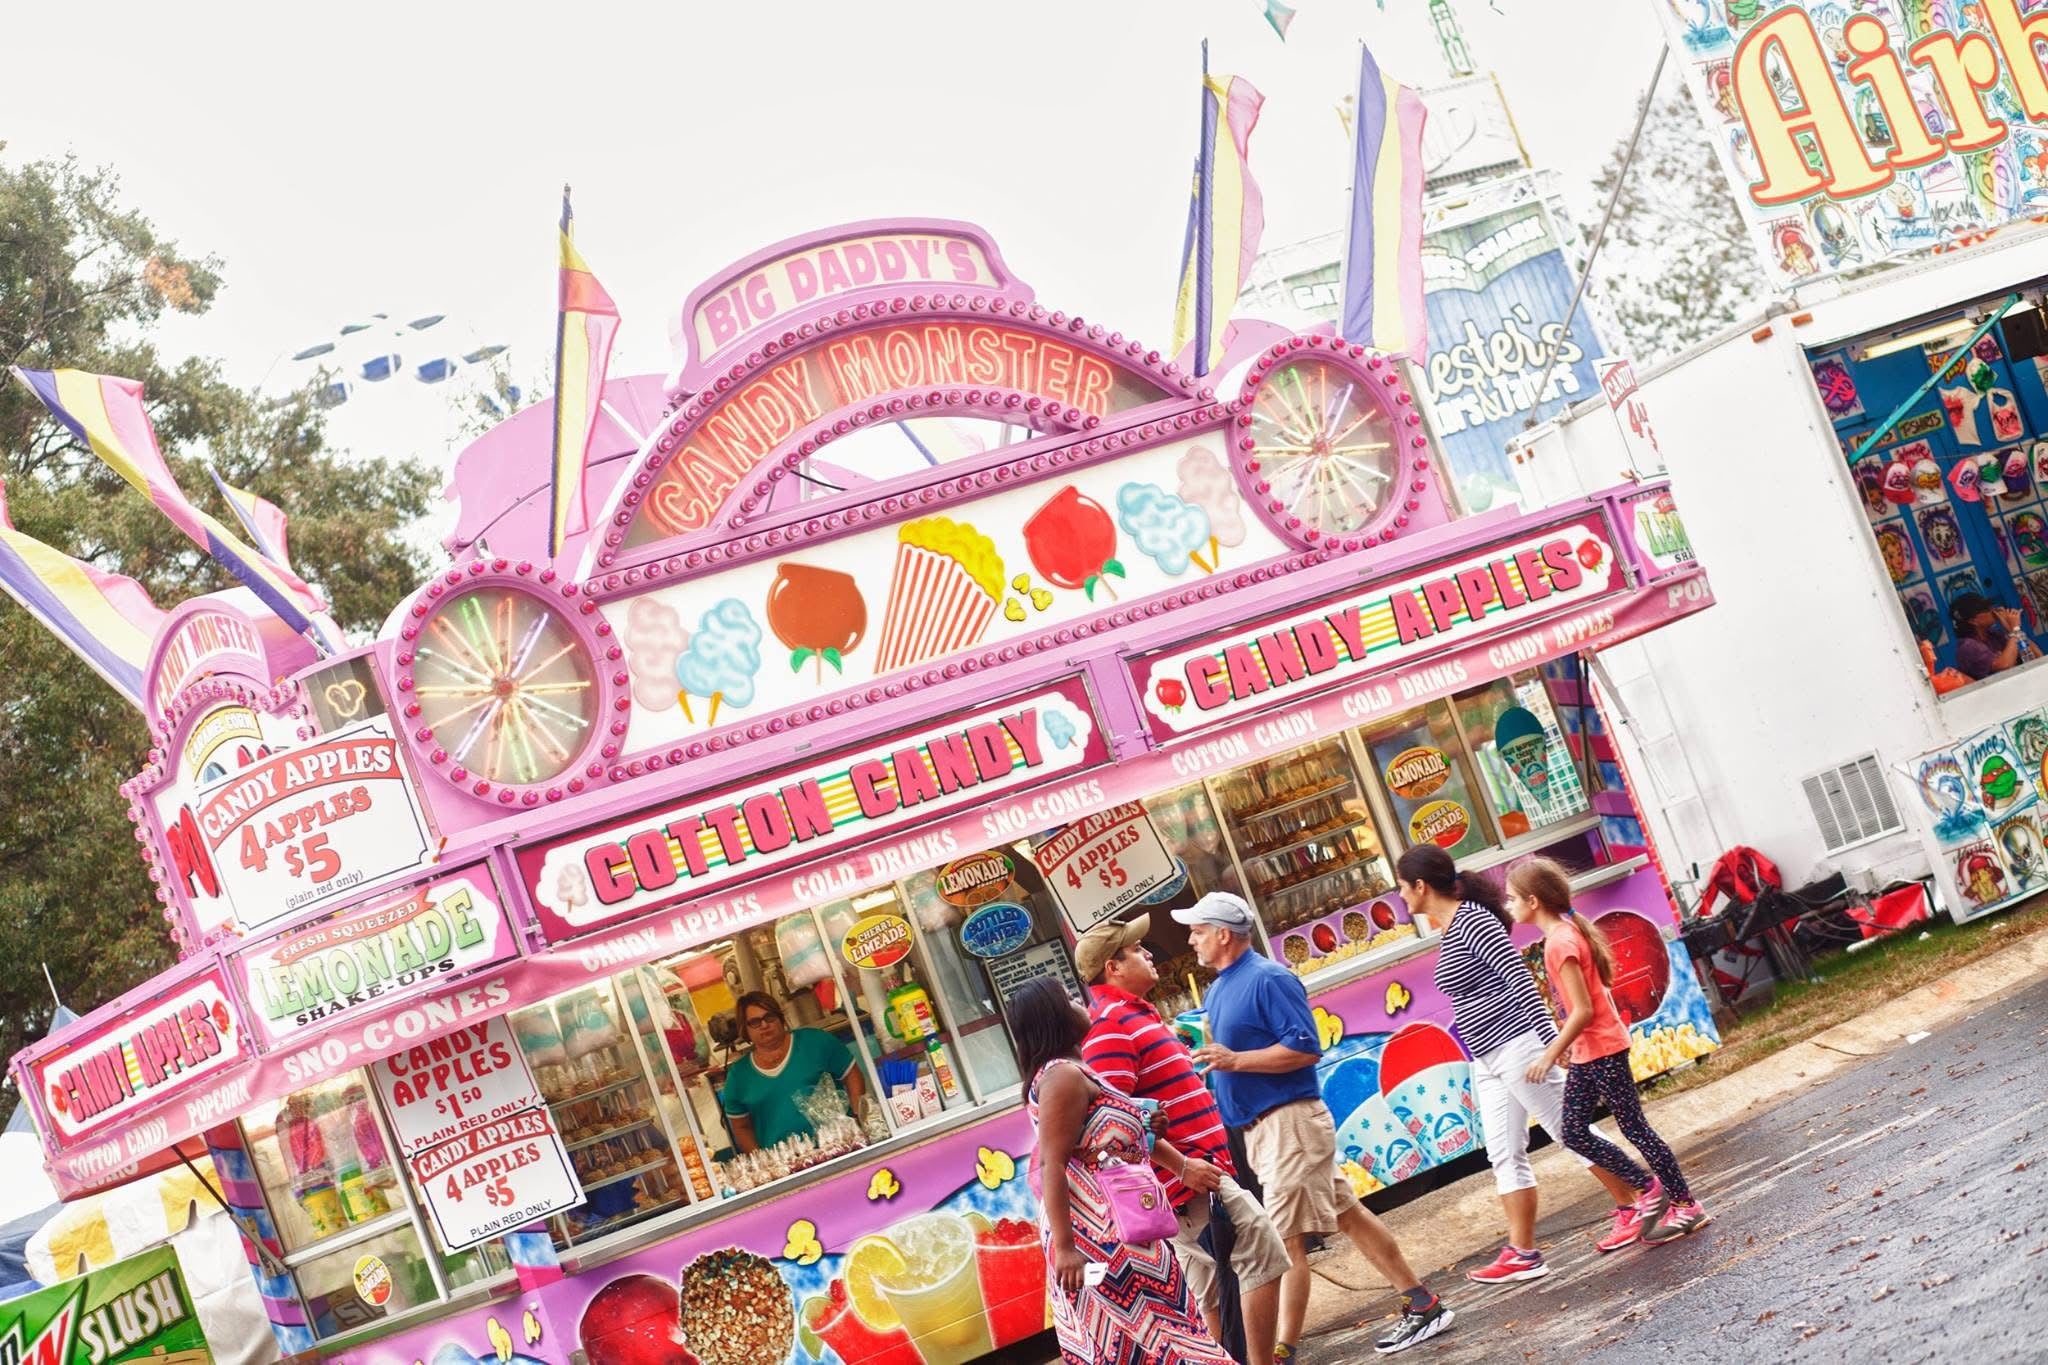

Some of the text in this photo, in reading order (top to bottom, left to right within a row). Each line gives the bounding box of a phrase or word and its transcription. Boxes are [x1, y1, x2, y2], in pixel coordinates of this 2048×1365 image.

[704, 237, 978, 346] BIG DADDY'S
[1426, 304, 1583, 401] ester's
[653, 326, 1115, 534] CANDY MONSTER
[187, 615, 258, 658] MONSTER
[1185, 539, 1584, 711] CANDY APPLES
[1172, 608, 1615, 775] COTTON CANDY COLD DRINKS CANDY APPLES
[203, 744, 394, 836] CANDY APPLES
[1388, 752, 1446, 788] LEMONADE
[238, 823, 267, 873] 4
[265, 786, 373, 850] APPLES
[586, 708, 1044, 905] COTTON CANDY
[1040, 824, 1082, 869] CANDY
[1082, 801, 1142, 840] APPLES
[1417, 807, 1464, 843] LIMEADE
[1422, 802, 1450, 826] CHERRY
[284, 831, 342, 884] $5
[286, 869, 365, 910] (plain red only)
[580, 778, 1105, 973] CANDY APPLES COLD DRINKS SNO-CONES
[941, 856, 1009, 896] LEMONADE
[1065, 824, 1142, 891] 4 APPLES
[1098, 858, 1129, 889] $5
[280, 900, 420, 959] FRESH SQUEEZED
[1091, 874, 1156, 921] PLAIN RED ONLY
[252, 888, 485, 1021] LEMONADE
[850, 926, 908, 964] LIMEADE
[857, 918, 894, 944] CHERRY
[974, 925, 1019, 947] WATER
[296, 958, 457, 1026] SHAKE-UPS
[59, 999, 222, 1123] CANDY APPLES
[282, 978, 511, 1084] SNO-CONES
[388, 1018, 490, 1077] CANDY
[393, 1042, 512, 1108] APPLES
[68, 1140, 122, 1180] COTTON
[124, 1118, 169, 1151] CANDY
[185, 1084, 251, 1127] POPCORN
[414, 1097, 528, 1149] PLAIN RED ONLY
[418, 1113, 547, 1178] CANDY APPLES
[446, 1143, 542, 1203] 4 APPLES
[485, 1175, 515, 1207] $5
[469, 1199, 554, 1238] PLAIN RED ONLY
[80, 1273, 185, 1365] SLUSH
